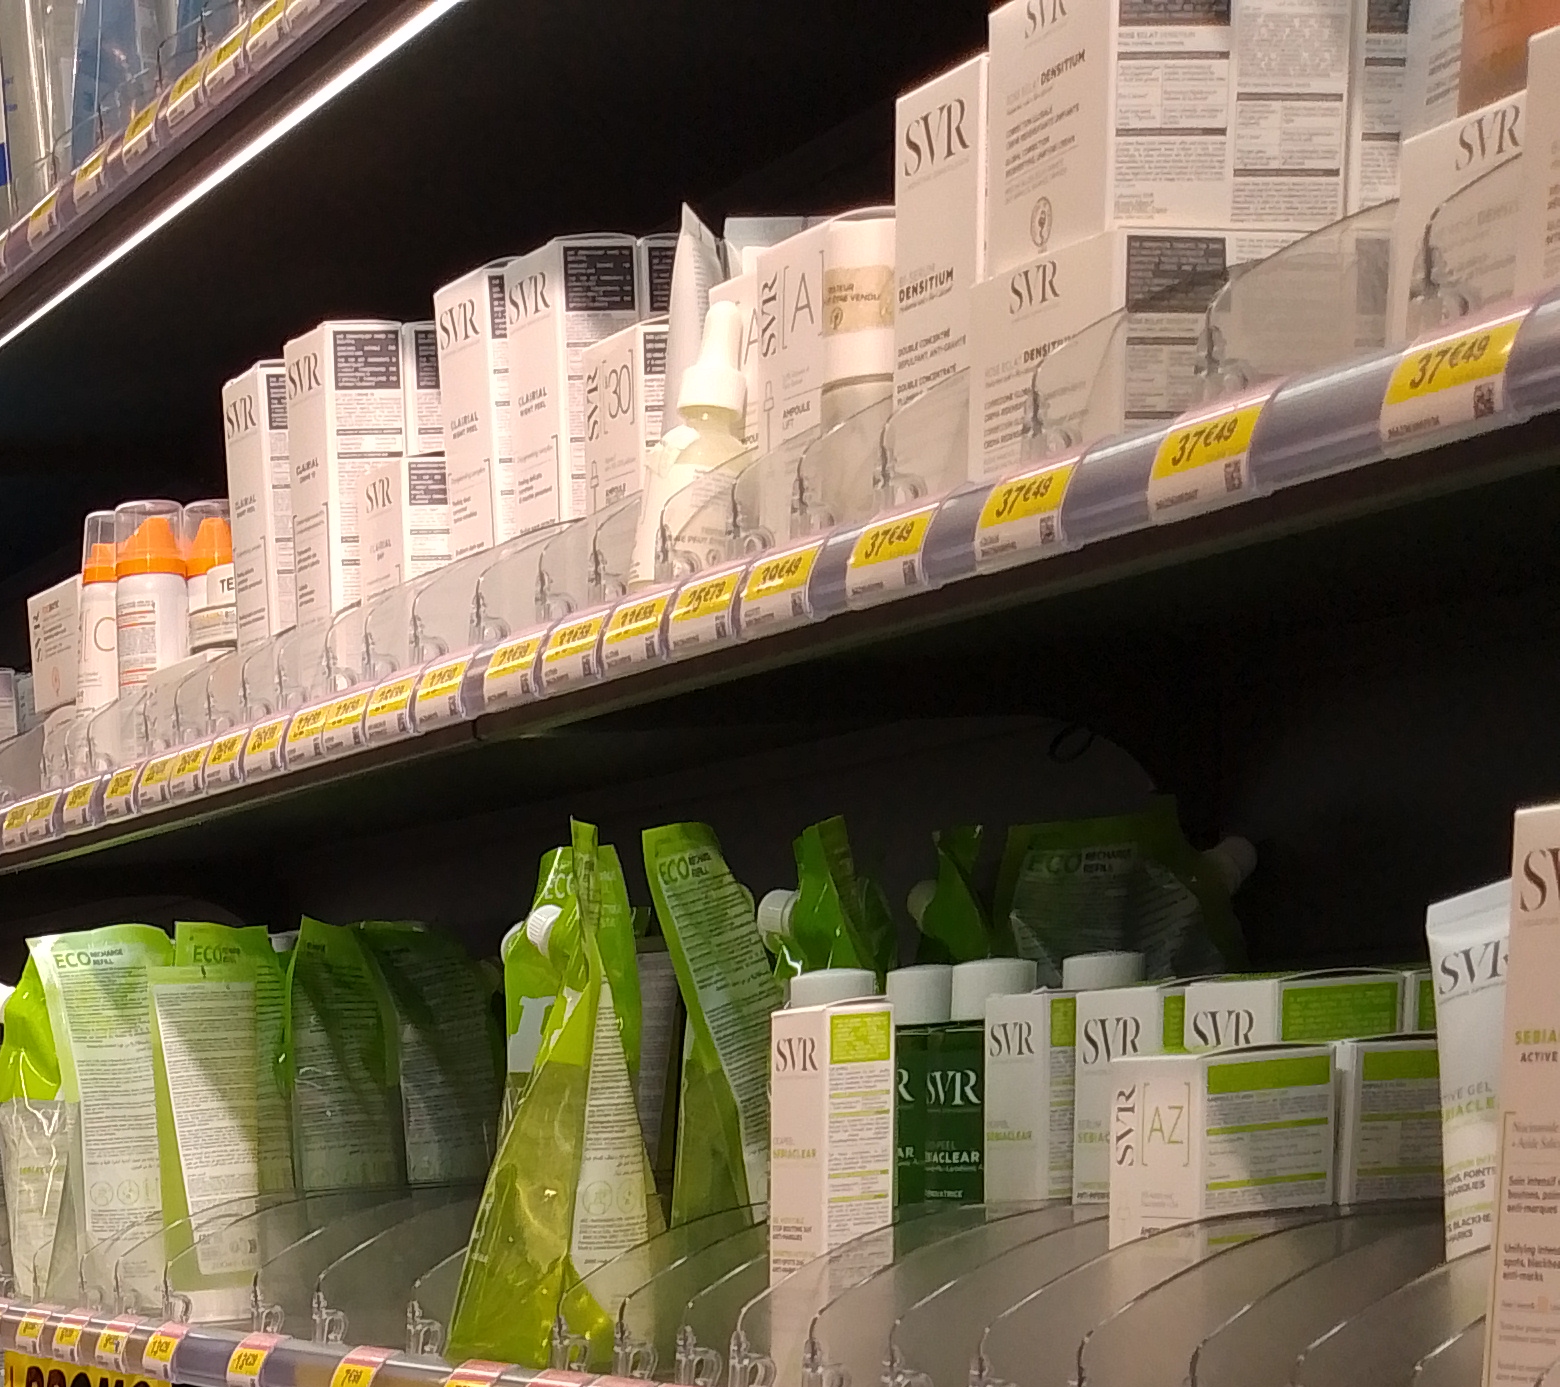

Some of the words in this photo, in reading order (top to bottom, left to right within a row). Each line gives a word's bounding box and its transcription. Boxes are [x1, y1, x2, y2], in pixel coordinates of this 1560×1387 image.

[1024, 0, 1068, 39] SVR
[1040, 49, 1086, 86] DENSITIUM
[904, 98, 970, 177] SVR
[1455, 103, 1524, 171] SVR
[509, 274, 551, 325] SVR
[898, 266, 954, 304] DENSITIUM
[1009, 260, 1061, 315] SVR
[440, 299, 480, 351] SVR
[761, 271, 778, 358] SVR
[289, 353, 322, 400] SVR
[1409, 335, 1490, 391] 37€49
[226, 394, 256, 438] SVR
[586, 366, 600, 442] SVR
[1171, 415, 1238, 467] 37€49
[366, 476, 392, 513] SVR
[996, 475, 1054, 518] 37€49
[864, 519, 915, 559] 37€49
[659, 855, 690, 886] ECO
[53, 951, 91, 969] ECO
[193, 945, 223, 963] ECO
[990, 1021, 1034, 1057] SVR
[1083, 1016, 1141, 1064] SVR
[1192, 1008, 1255, 1047] SVR
[776, 1037, 818, 1073] SVR
[926, 1069, 981, 1106] SVR
[1116, 1084, 1136, 1167] SVR
